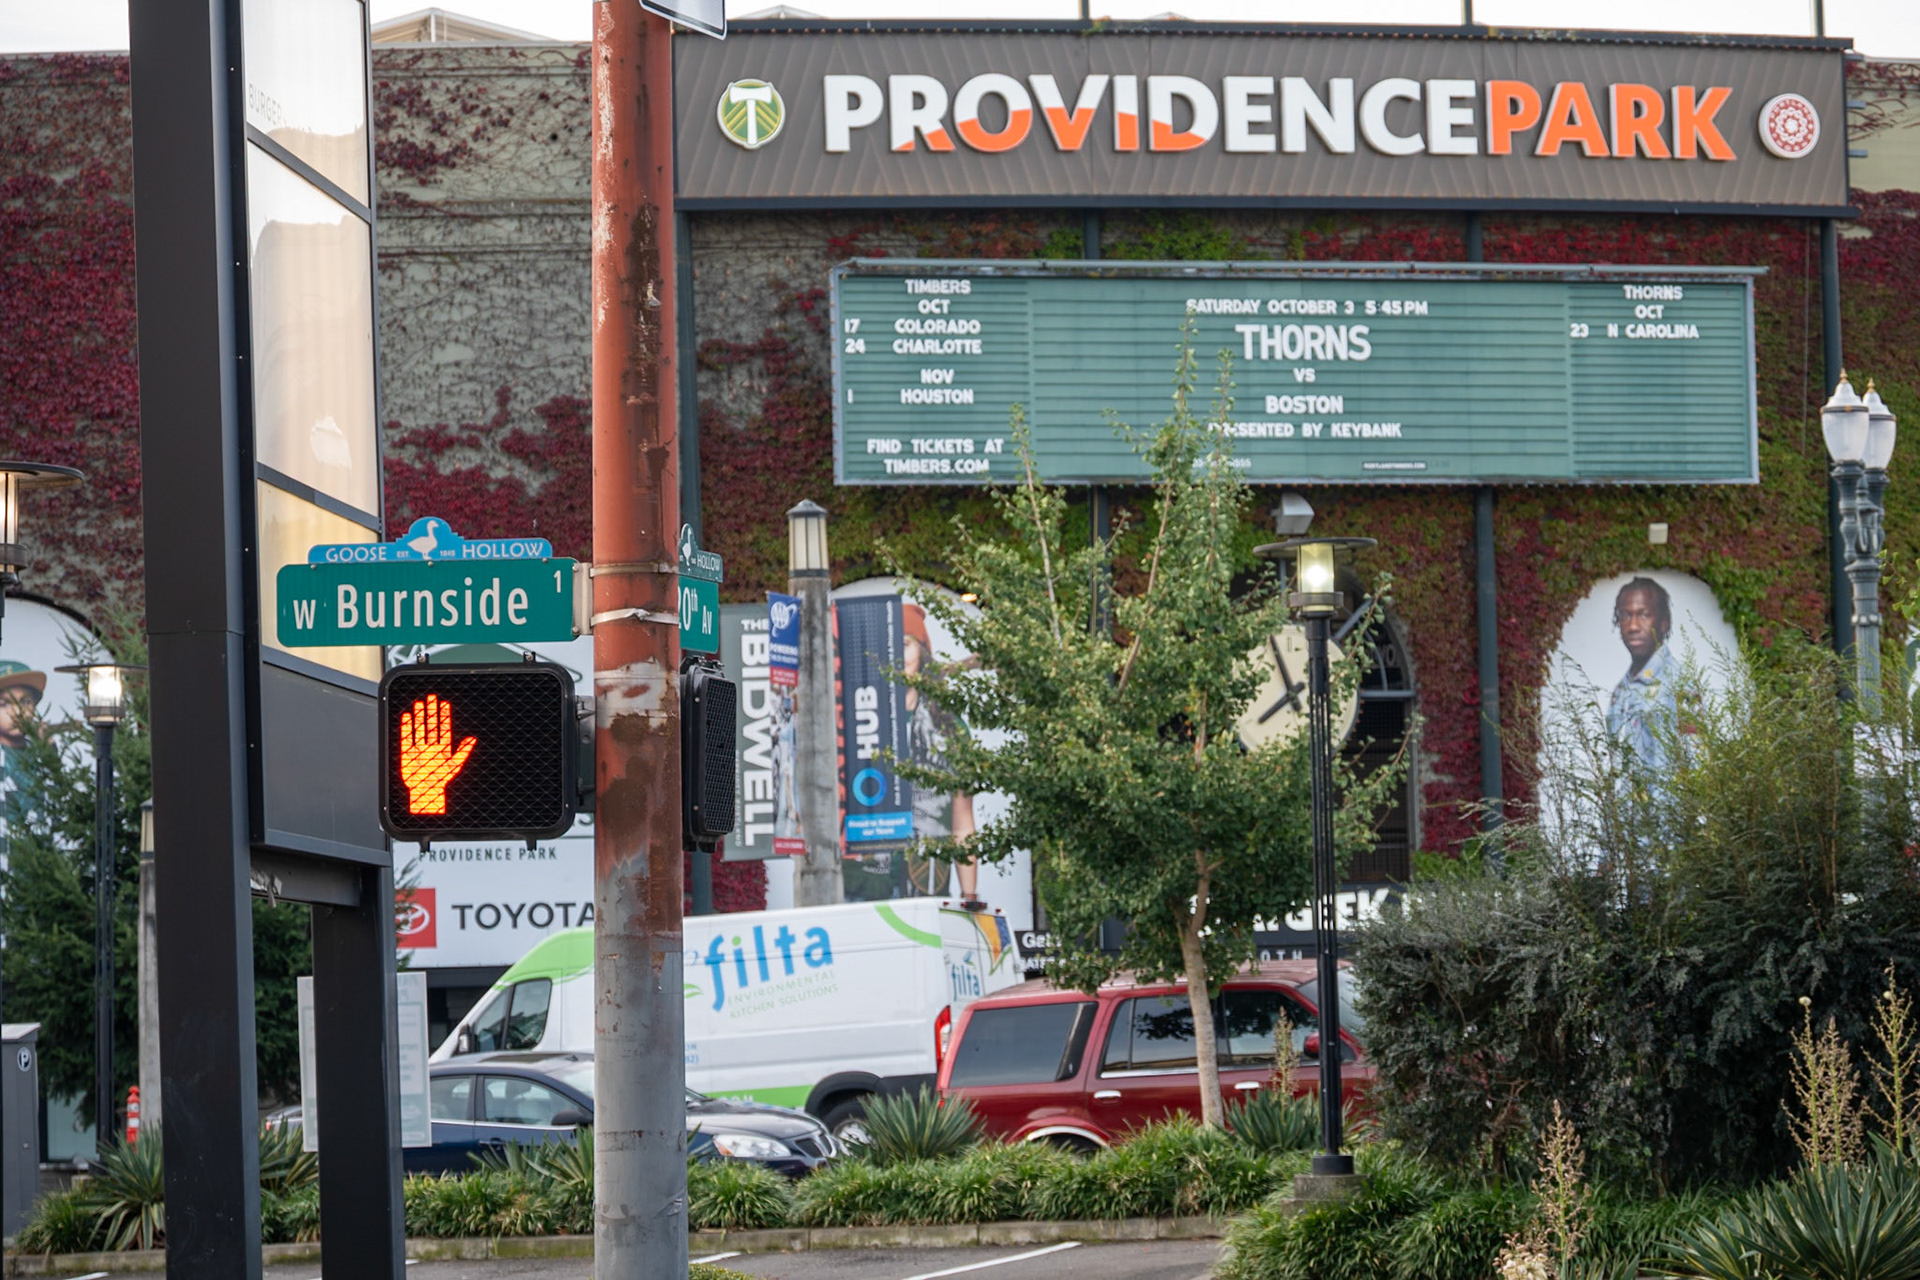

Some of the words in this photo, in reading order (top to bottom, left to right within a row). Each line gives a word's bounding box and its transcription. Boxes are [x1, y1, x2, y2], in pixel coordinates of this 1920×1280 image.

[904, 279, 971, 295] TIMBERS
[1623, 284, 1684, 301] THORNS
[917, 299, 951, 314] OCT
[1185, 299, 1261, 315] SATURDAY
[1267, 299, 1337, 315] OCTOBER
[1344, 300, 1355, 315] 3
[1634, 304, 1664, 321] OCT
[844, 318, 861, 334] 17
[894, 318, 982, 335] COLORADO
[1569, 322, 1590, 340] 23
[1607, 323, 1620, 339] N
[1625, 322, 1700, 341] CAROLINA
[845, 338, 866, 354] 24
[892, 338, 983, 354] CHARLOTTE
[1235, 324, 1372, 361] THORNS
[920, 368, 955, 384] NOV
[1293, 368, 1316, 383] VS
[900, 388, 974, 405] HOUSTON
[1265, 395, 1344, 414] BOSTON
[1302, 422, 1323, 438] BY
[1331, 422, 1402, 439] KEYBANK
[866, 438, 902, 454] FIND
[910, 438, 975, 454] TICKETS
[984, 438, 1004, 454] AT
[883, 458, 990, 474] TIMBERS.COM
[325, 546, 387, 563] GOOSE
[462, 542, 544, 559] HOLLOW
[697, 554, 720, 571] HOLLOW
[293, 599, 316, 630] W
[337, 577, 529, 629] Burnside
[553, 570, 562, 593] 1
[702, 605, 712, 635] Av
[741, 619, 769, 631] THE
[855, 685, 880, 760] HUB
[741, 634, 775, 846] BIDWELL
[418, 847, 512, 862] PROVIDENCE
[519, 846, 557, 860] PARK
[451, 902, 595, 930] TOYOTA
[704, 925, 833, 1013] filta
[727, 969, 836, 1007] ENVIRONMENTAL
[951, 962, 980, 1002] filta
[729, 999, 775, 1019] KITCHEN
[779, 983, 839, 1007] SOLUTIONS
